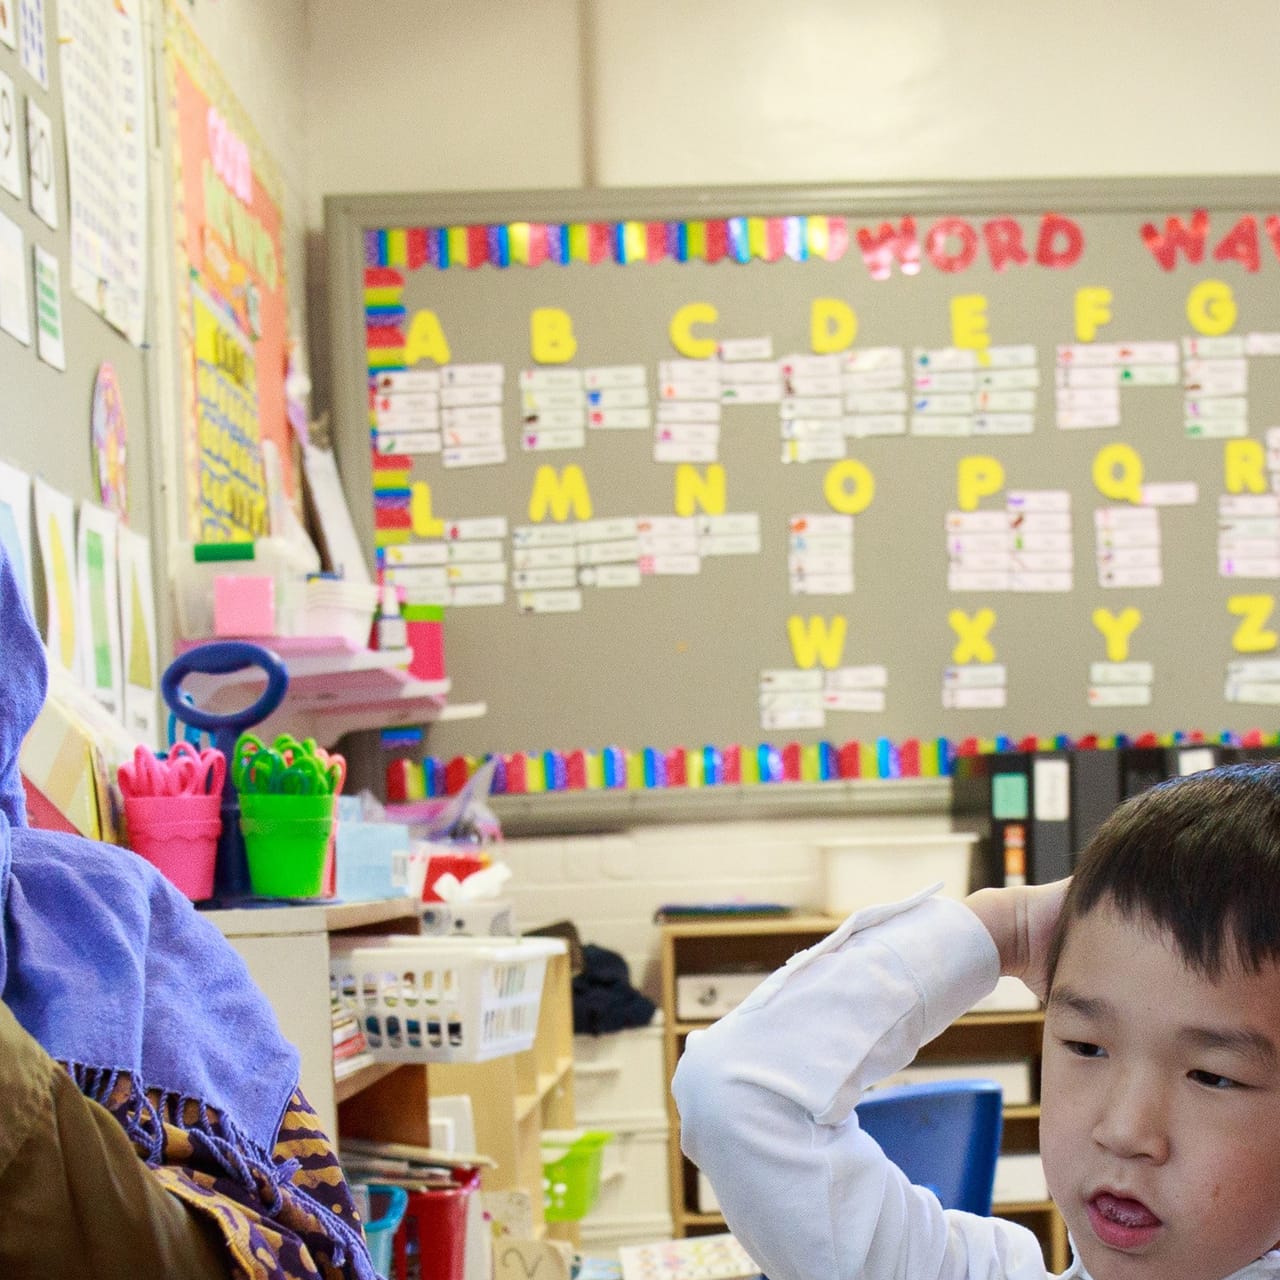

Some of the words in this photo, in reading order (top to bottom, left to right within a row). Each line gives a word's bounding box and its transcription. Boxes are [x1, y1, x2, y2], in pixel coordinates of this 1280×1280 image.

[856, 213, 1085, 280] WORD
[402, 308, 452, 366] A
[529, 306, 578, 366] B
[668, 302, 718, 360] C
[810, 298, 858, 356] D
[950, 295, 991, 352] E
[1074, 286, 1113, 344] F
[1185, 279, 1238, 337] G
[410, 480, 445, 539] L
[527, 463, 595, 524] M
[673, 462, 727, 518] N
[823, 458, 876, 516] O
[957, 455, 1006, 513] P
[1091, 443, 1143, 505] Q
[1223, 437, 1268, 495] R
[786, 614, 849, 671] W
[947, 607, 998, 666] X
[1092, 606, 1143, 664] Y
[1226, 593, 1279, 654] Z
